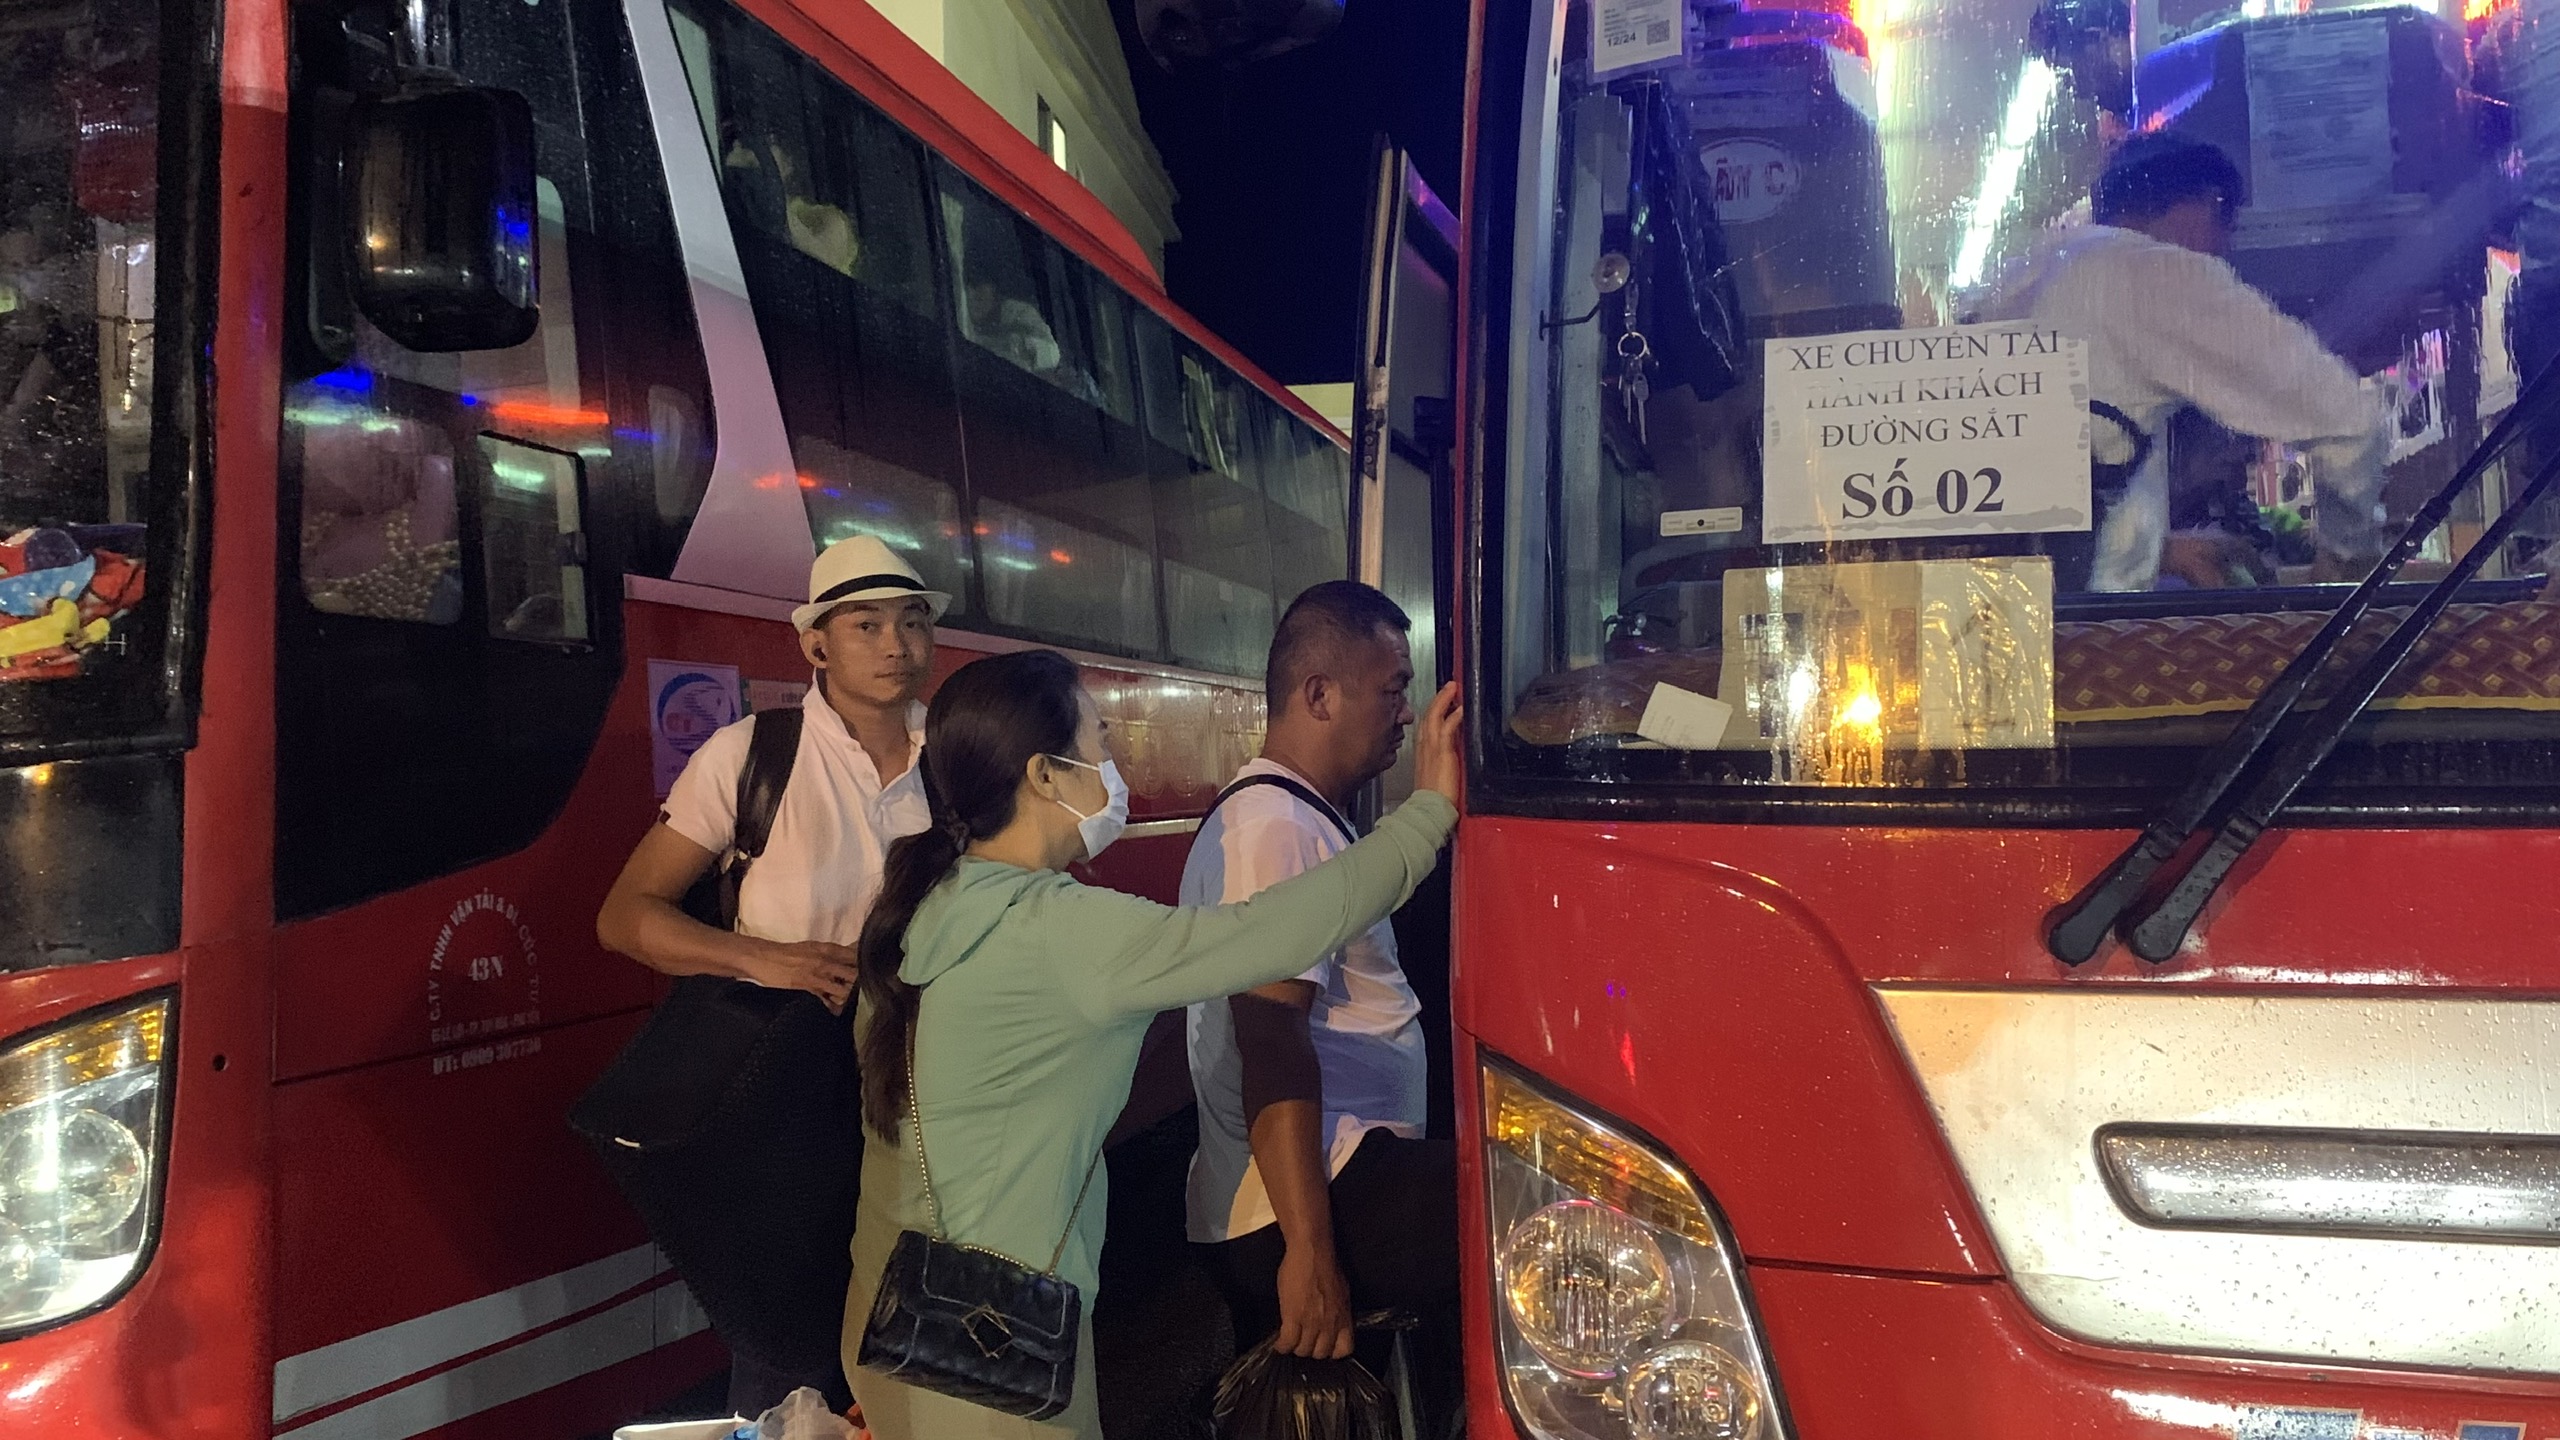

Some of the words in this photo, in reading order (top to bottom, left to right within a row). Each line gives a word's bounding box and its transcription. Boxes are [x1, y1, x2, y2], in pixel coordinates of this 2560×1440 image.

[1789, 344, 1834, 371] XE
[2001, 324, 2061, 358] TẢI
[1915, 367, 2044, 402] KHÁCH
[1820, 414, 1950, 448] ĐƯỜNG
[1960, 407, 2029, 440] SẮT
[1842, 457, 1914, 519] Số
[1936, 467, 2005, 514] 02
[430, 923, 454, 971] TNHH
[474, 887, 495, 911] TẢI
[496, 896, 505, 914] &
[468, 955, 504, 982] 43N
